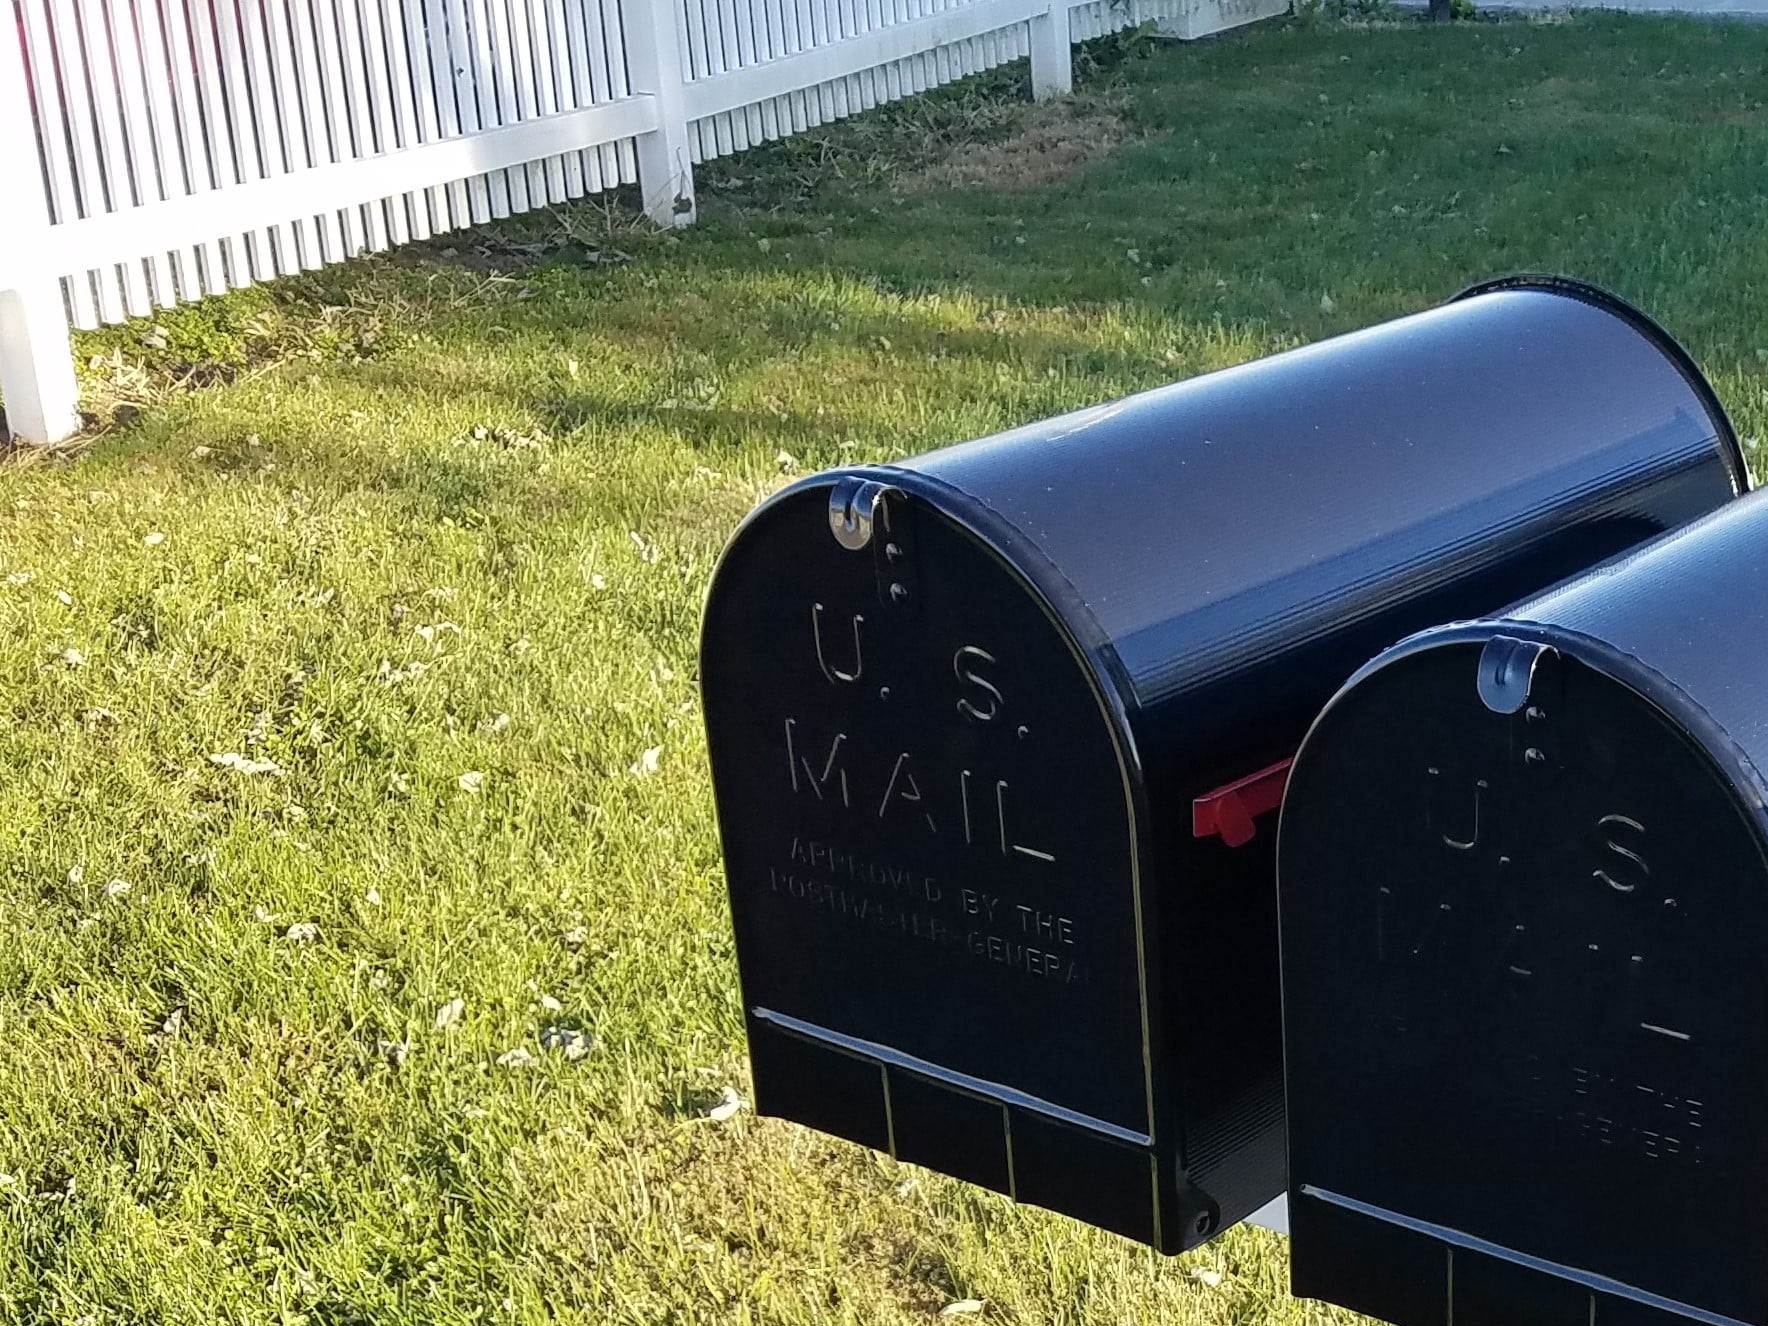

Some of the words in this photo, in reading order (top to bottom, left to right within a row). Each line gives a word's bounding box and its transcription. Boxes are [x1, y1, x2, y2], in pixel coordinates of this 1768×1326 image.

[785, 717, 1056, 863] MAIL
[961, 887, 999, 922] BY
[1015, 903, 1075, 945] THE
